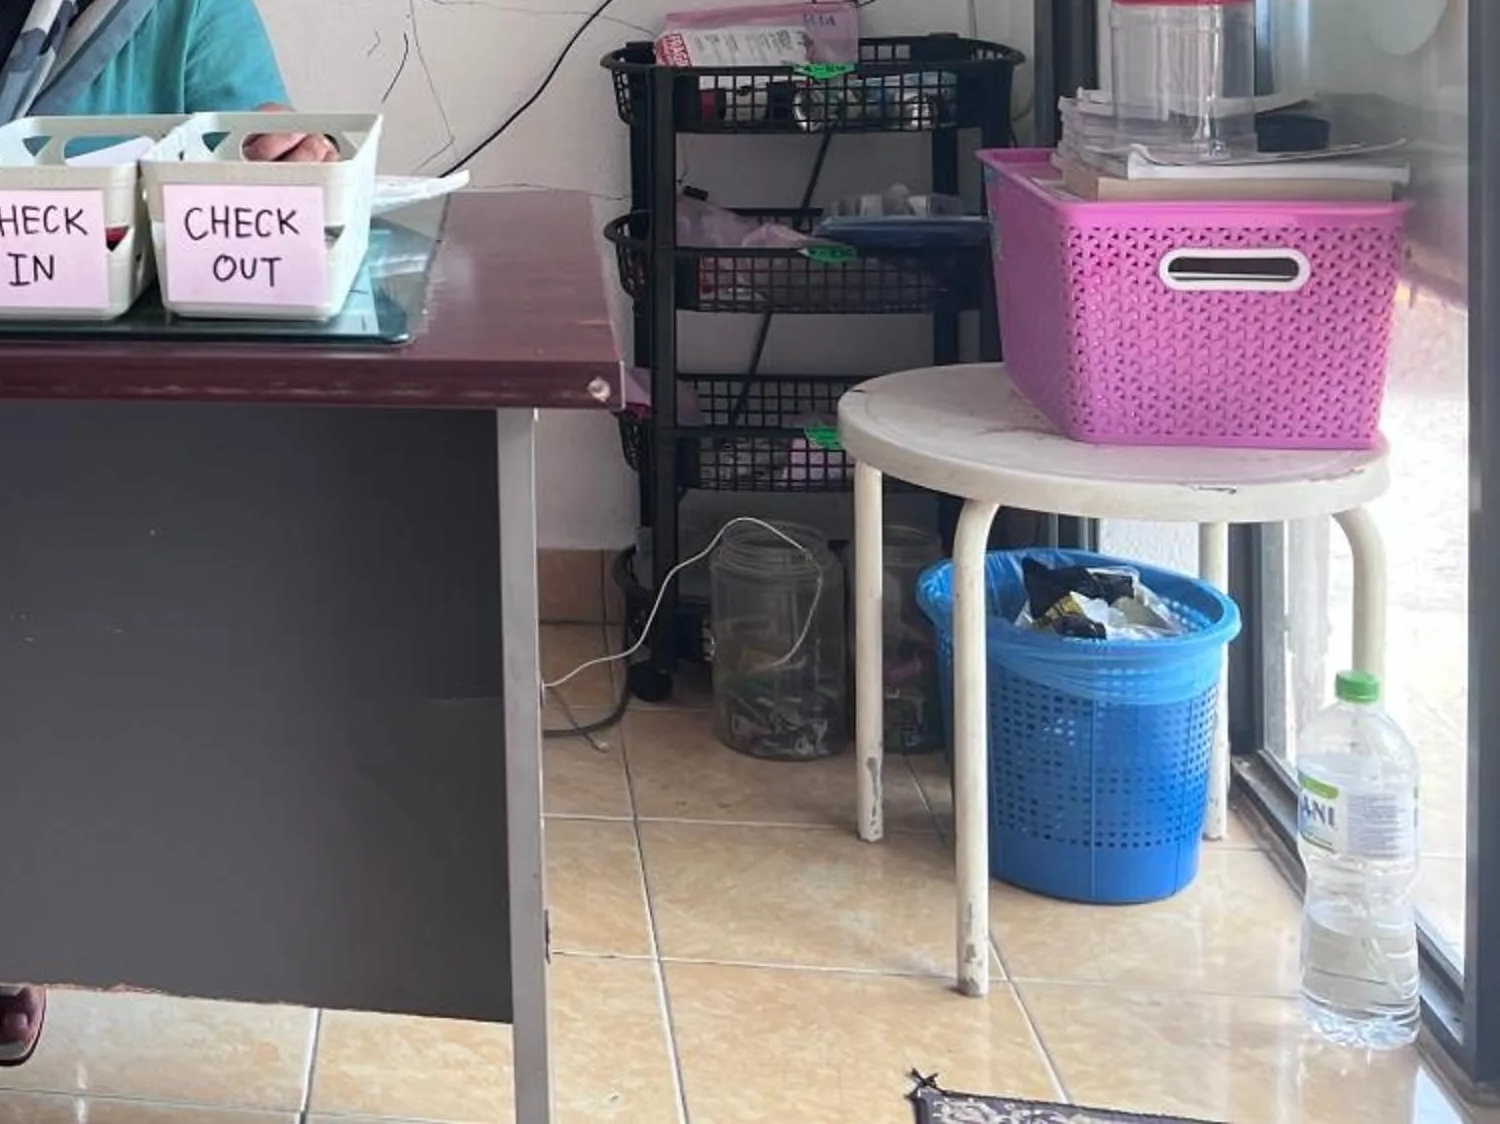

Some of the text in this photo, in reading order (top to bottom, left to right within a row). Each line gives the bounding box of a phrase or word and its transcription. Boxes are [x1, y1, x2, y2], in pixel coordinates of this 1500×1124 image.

[184, 205, 300, 240] CHECK
[6, 252, 55, 287] IN
[213, 254, 282, 288] OUT
